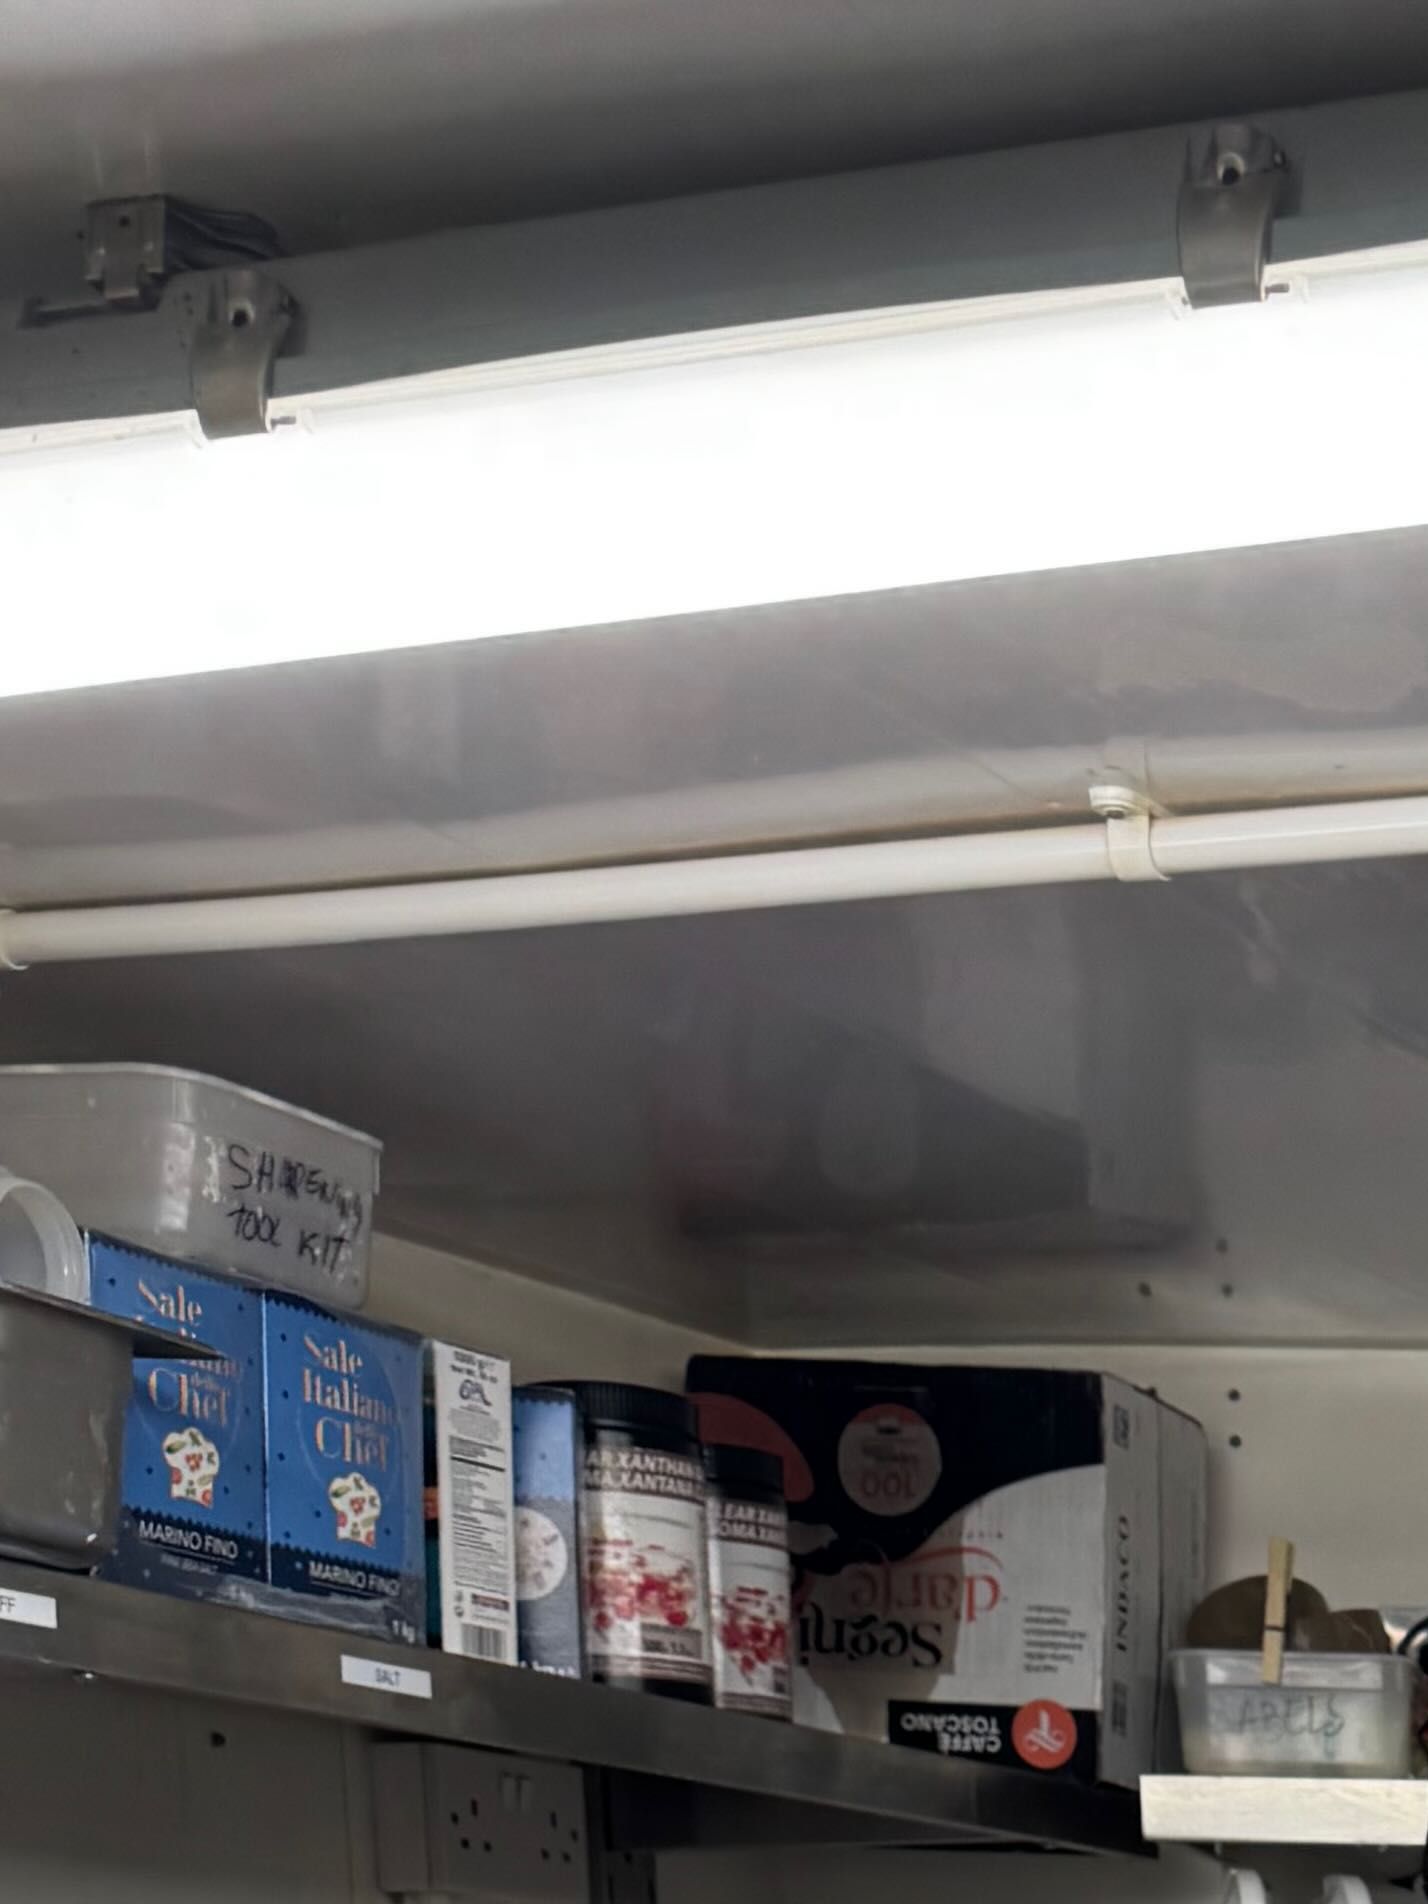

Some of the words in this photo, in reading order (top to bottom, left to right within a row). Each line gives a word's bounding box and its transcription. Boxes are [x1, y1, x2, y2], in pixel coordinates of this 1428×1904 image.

[298, 1229, 350, 1273] KIT
[137, 1279, 202, 1326] Sale
[304, 1336, 363, 1376] Sale
[139, 1520, 202, 1552] MARINO
[204, 1535, 239, 1560] FINO
[309, 1561, 366, 1589] MARINO
[368, 1571, 401, 1597] FINO
[799, 1602, 943, 1669] Segni
[900, 1711, 1002, 1733] TOSCANO
